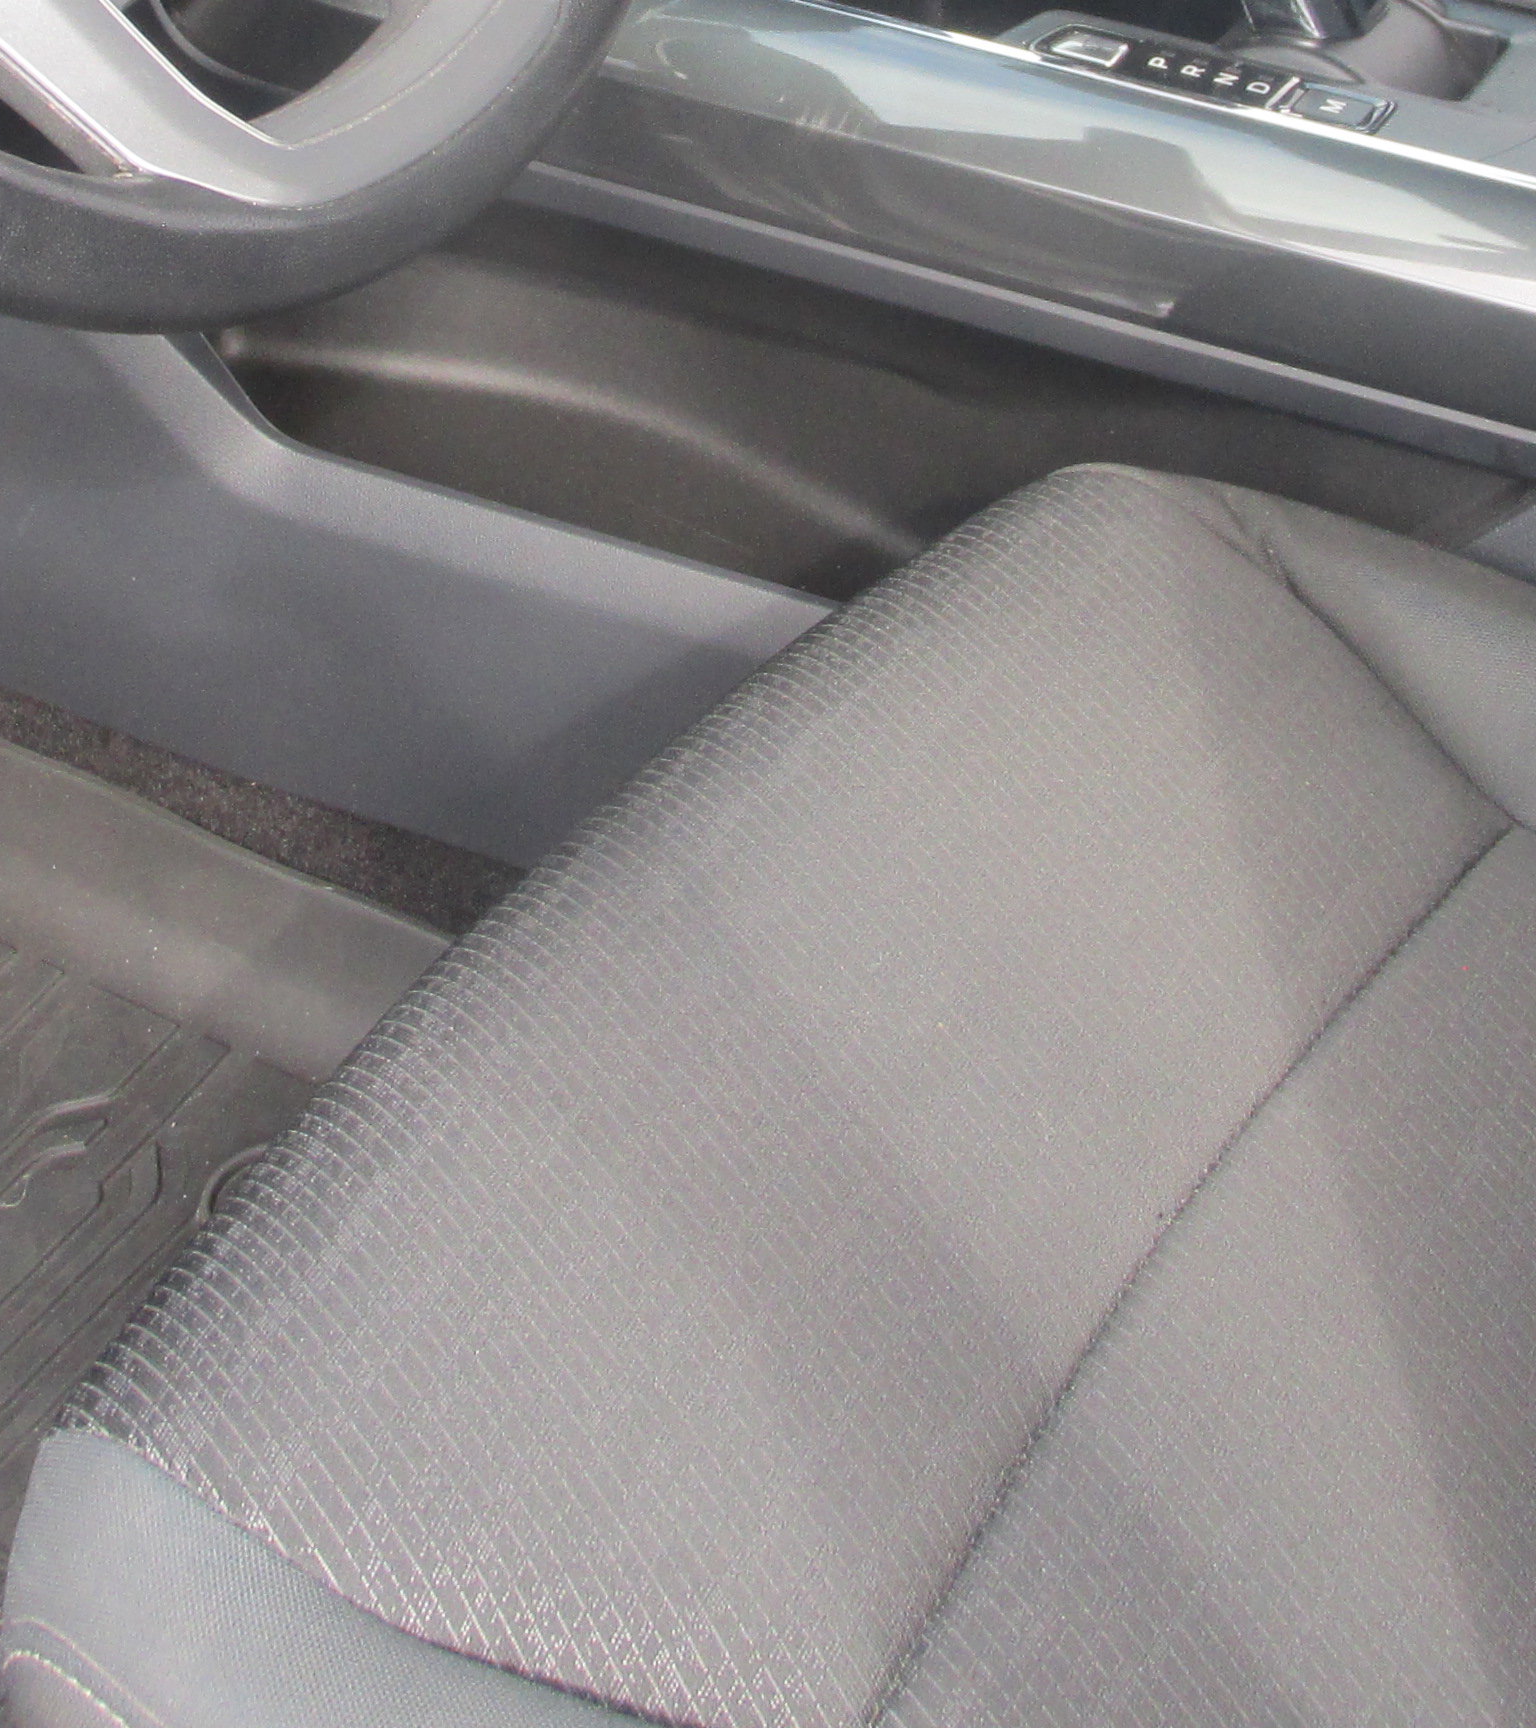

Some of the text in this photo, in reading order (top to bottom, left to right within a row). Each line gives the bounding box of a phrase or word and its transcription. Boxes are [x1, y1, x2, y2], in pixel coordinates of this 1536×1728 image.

[1147, 56, 1271, 95] P R N D
[1319, 98, 1347, 114] M
